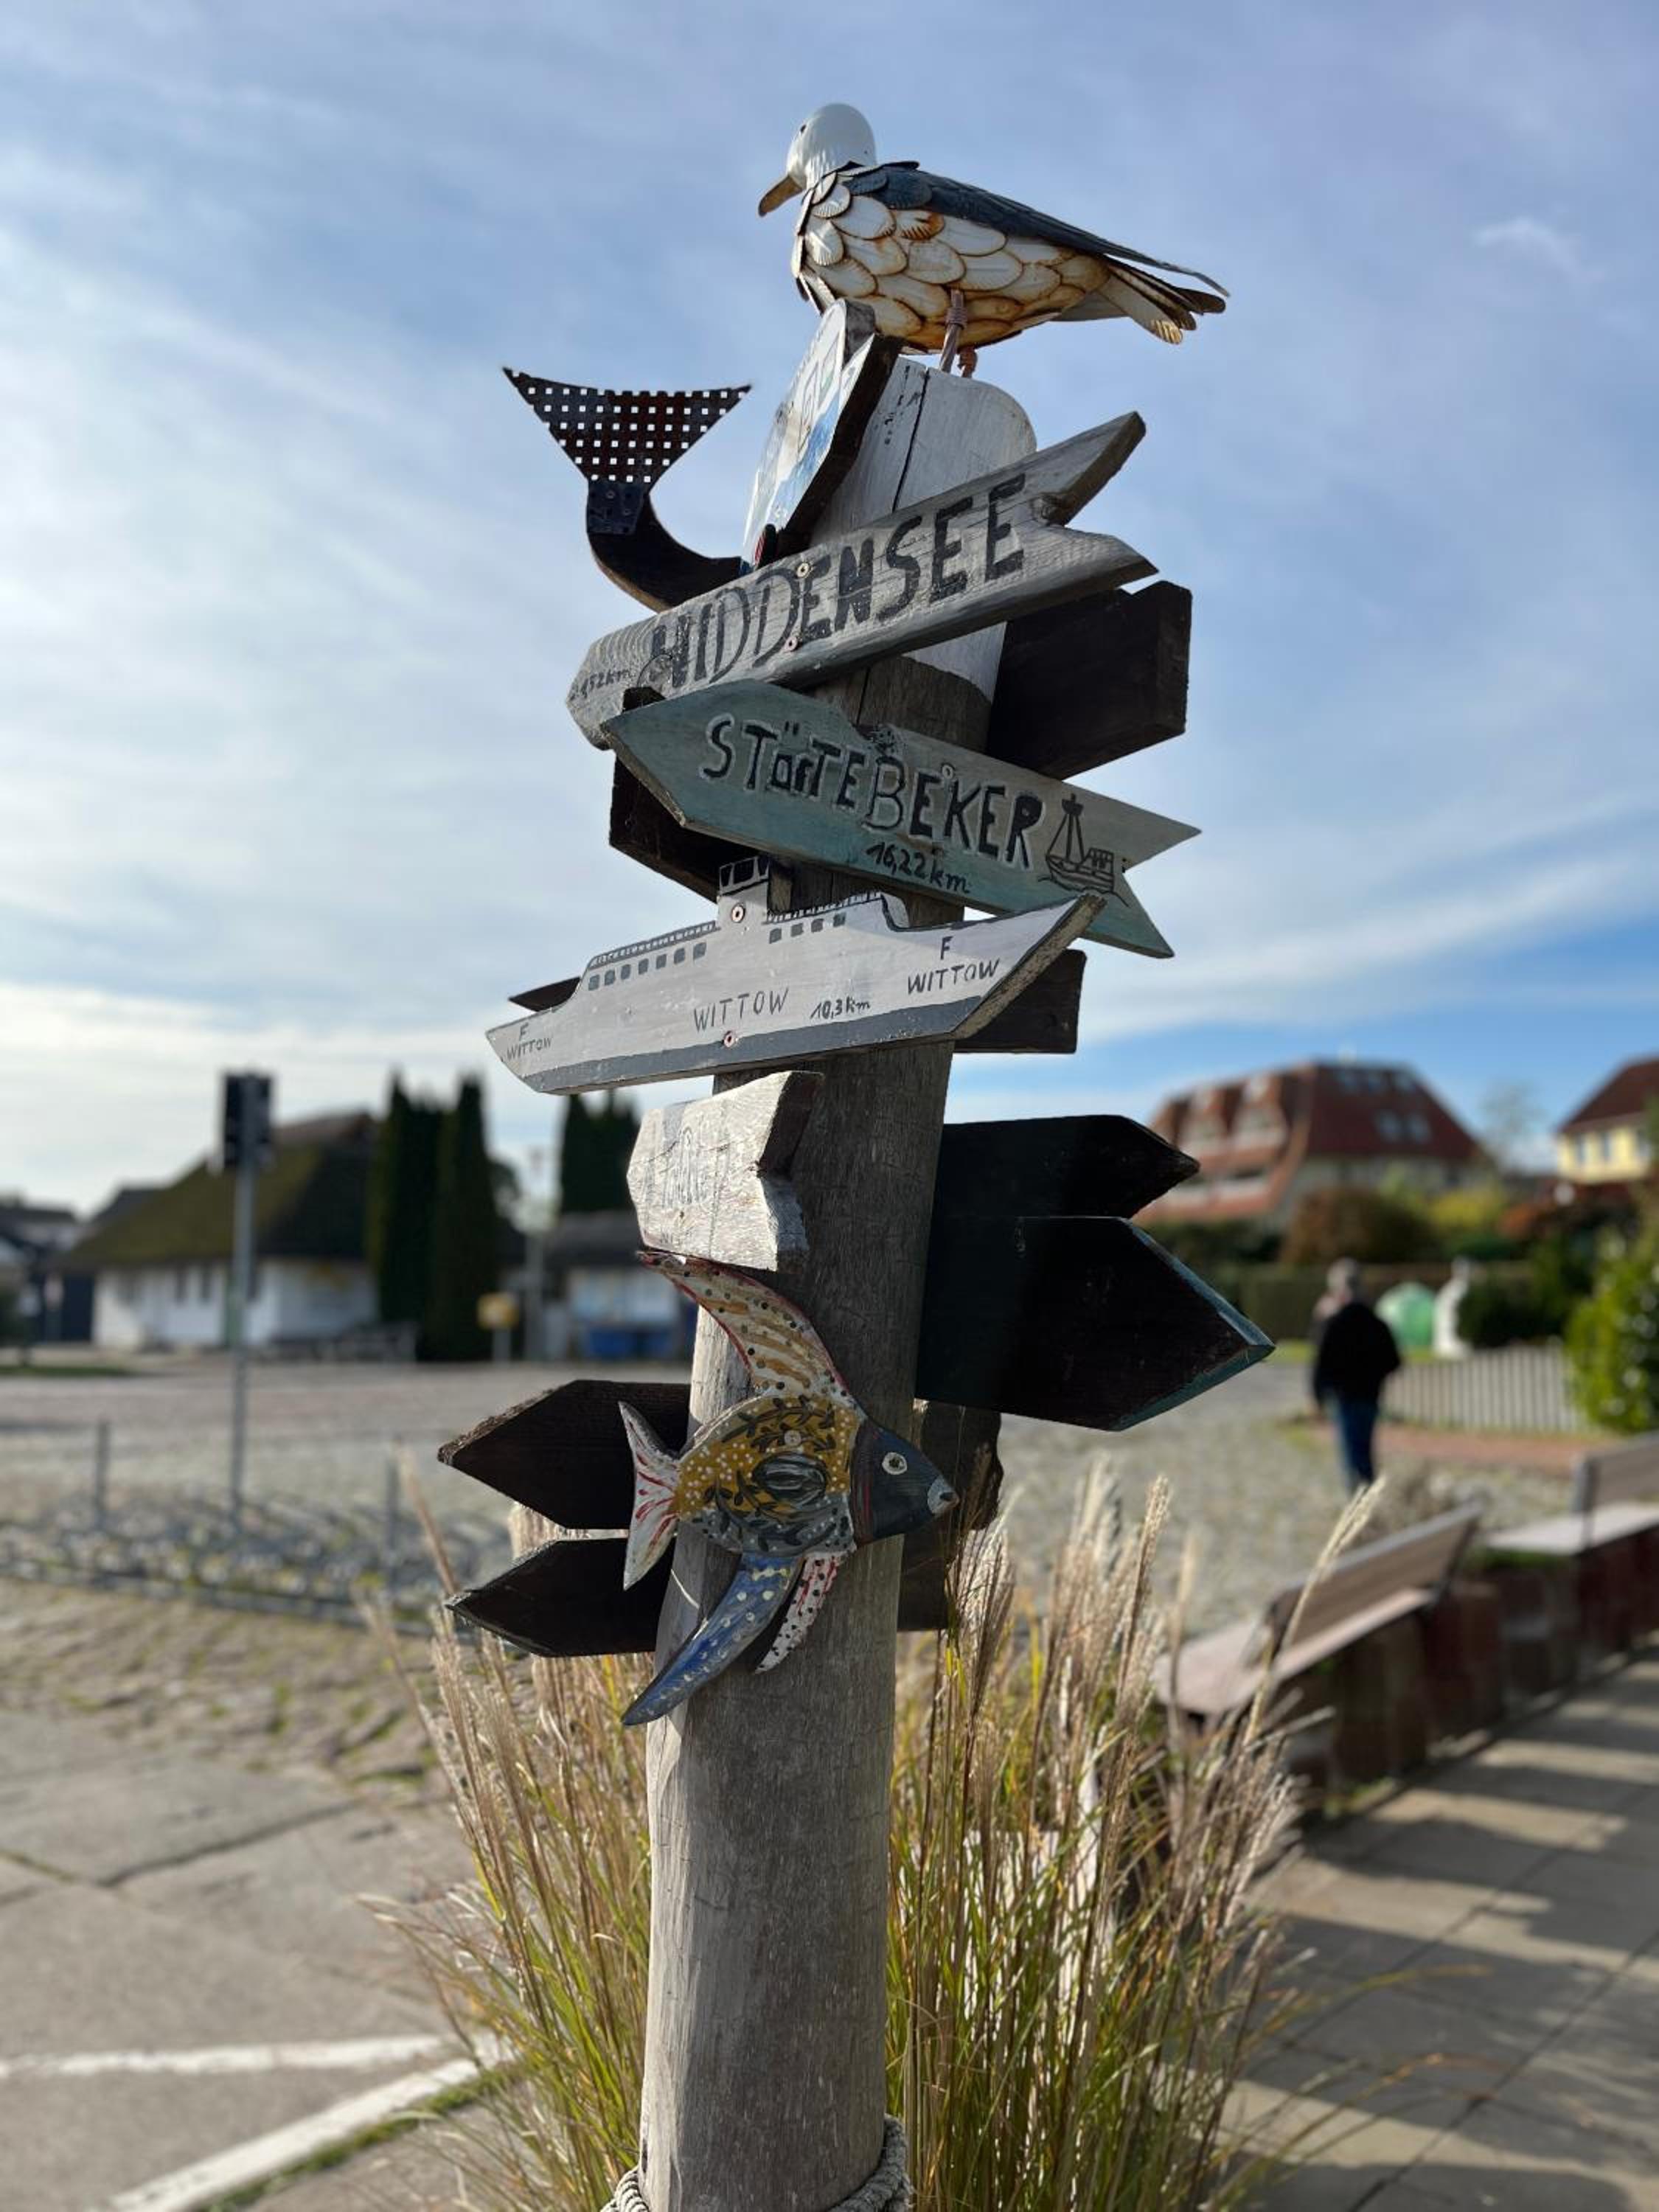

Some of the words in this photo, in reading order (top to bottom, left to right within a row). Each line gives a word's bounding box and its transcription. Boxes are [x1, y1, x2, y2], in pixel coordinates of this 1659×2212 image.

[650, 473, 1026, 688] HIDDENSEE
[940, 936, 953, 960] F
[908, 958, 1001, 995] WITTOW
[693, 987, 790, 1033] WITTOW
[518, 1022, 529, 1041] F
[507, 1037, 552, 1061] WITTOW
